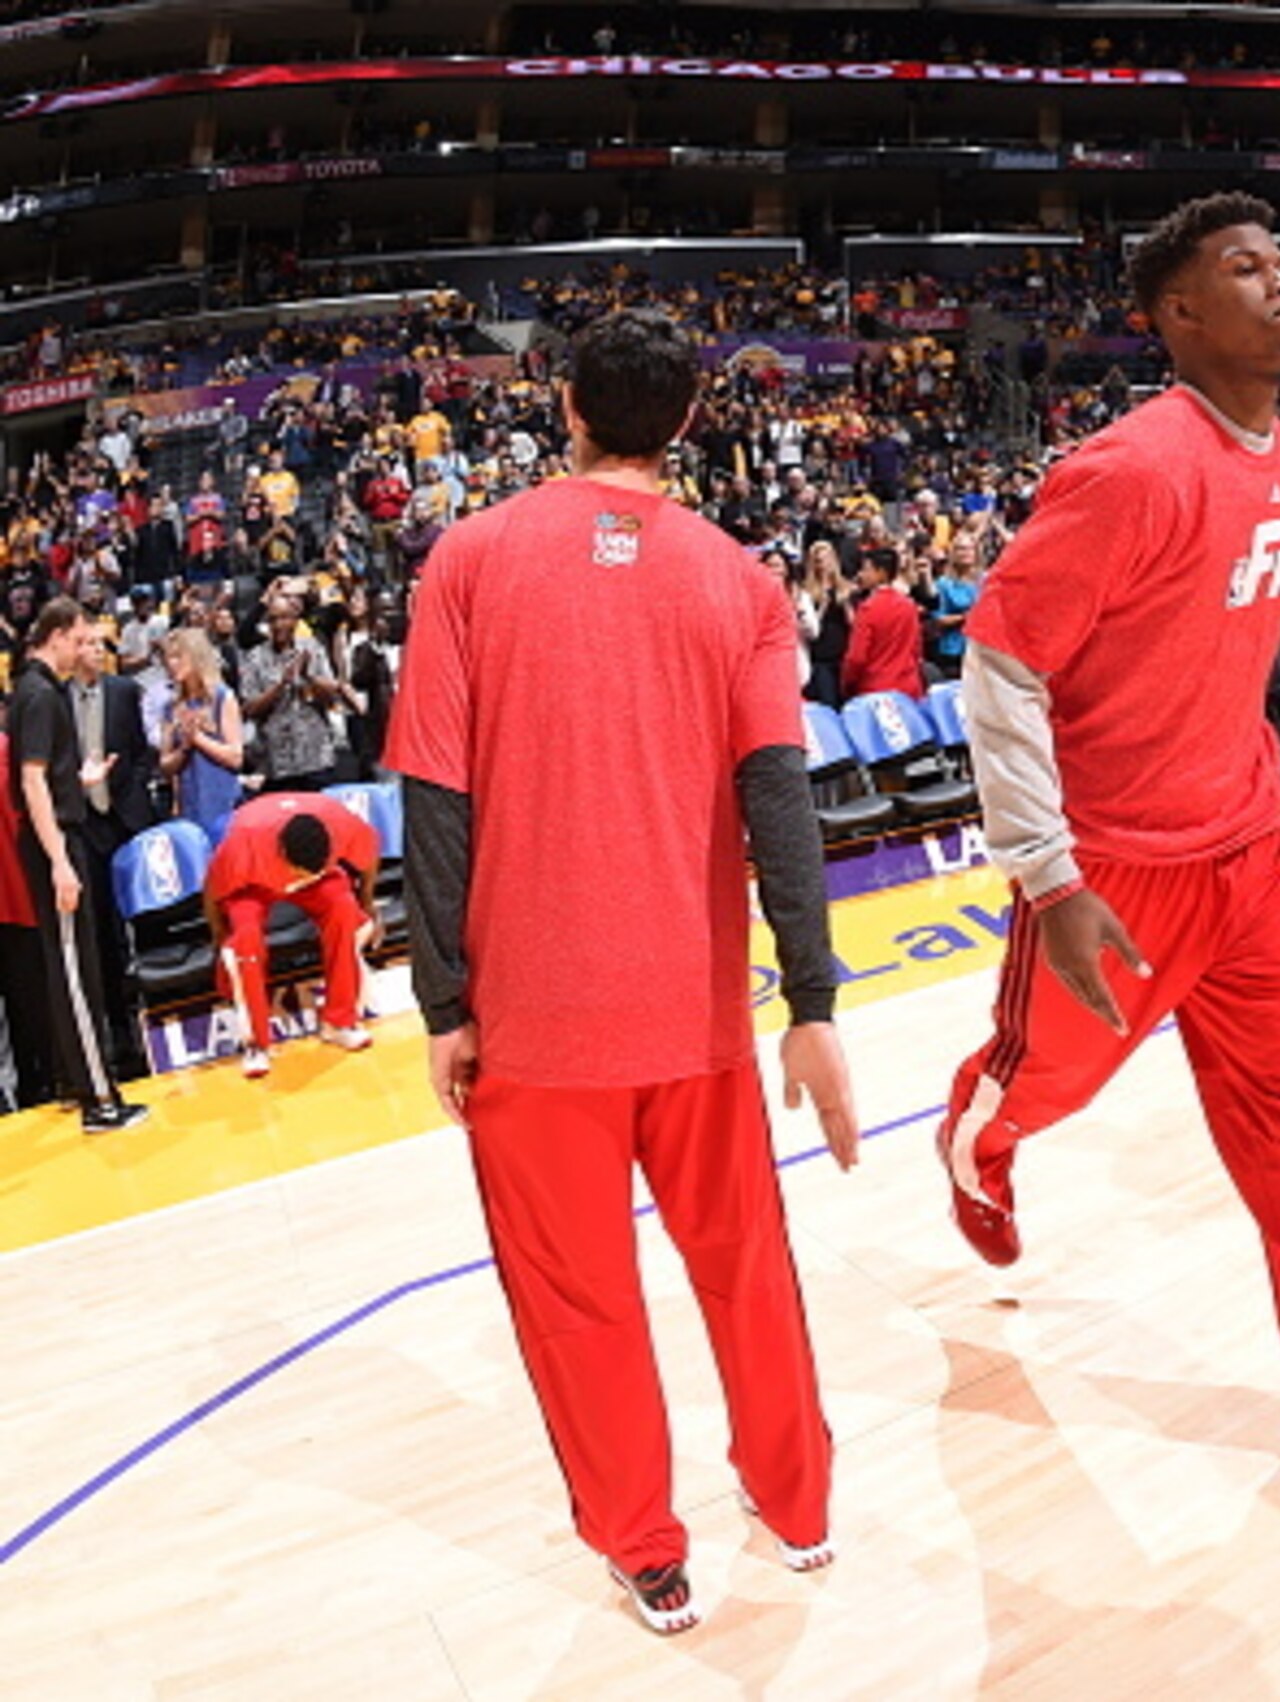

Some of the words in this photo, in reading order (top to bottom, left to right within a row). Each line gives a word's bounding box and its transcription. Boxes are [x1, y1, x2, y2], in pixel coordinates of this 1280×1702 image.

[505, 58, 893, 80] CHICAGO
[925, 65, 1189, 84] BULLS
[304, 158, 382, 179] TOYOTA
[4, 375, 94, 413] TOSHIBA
